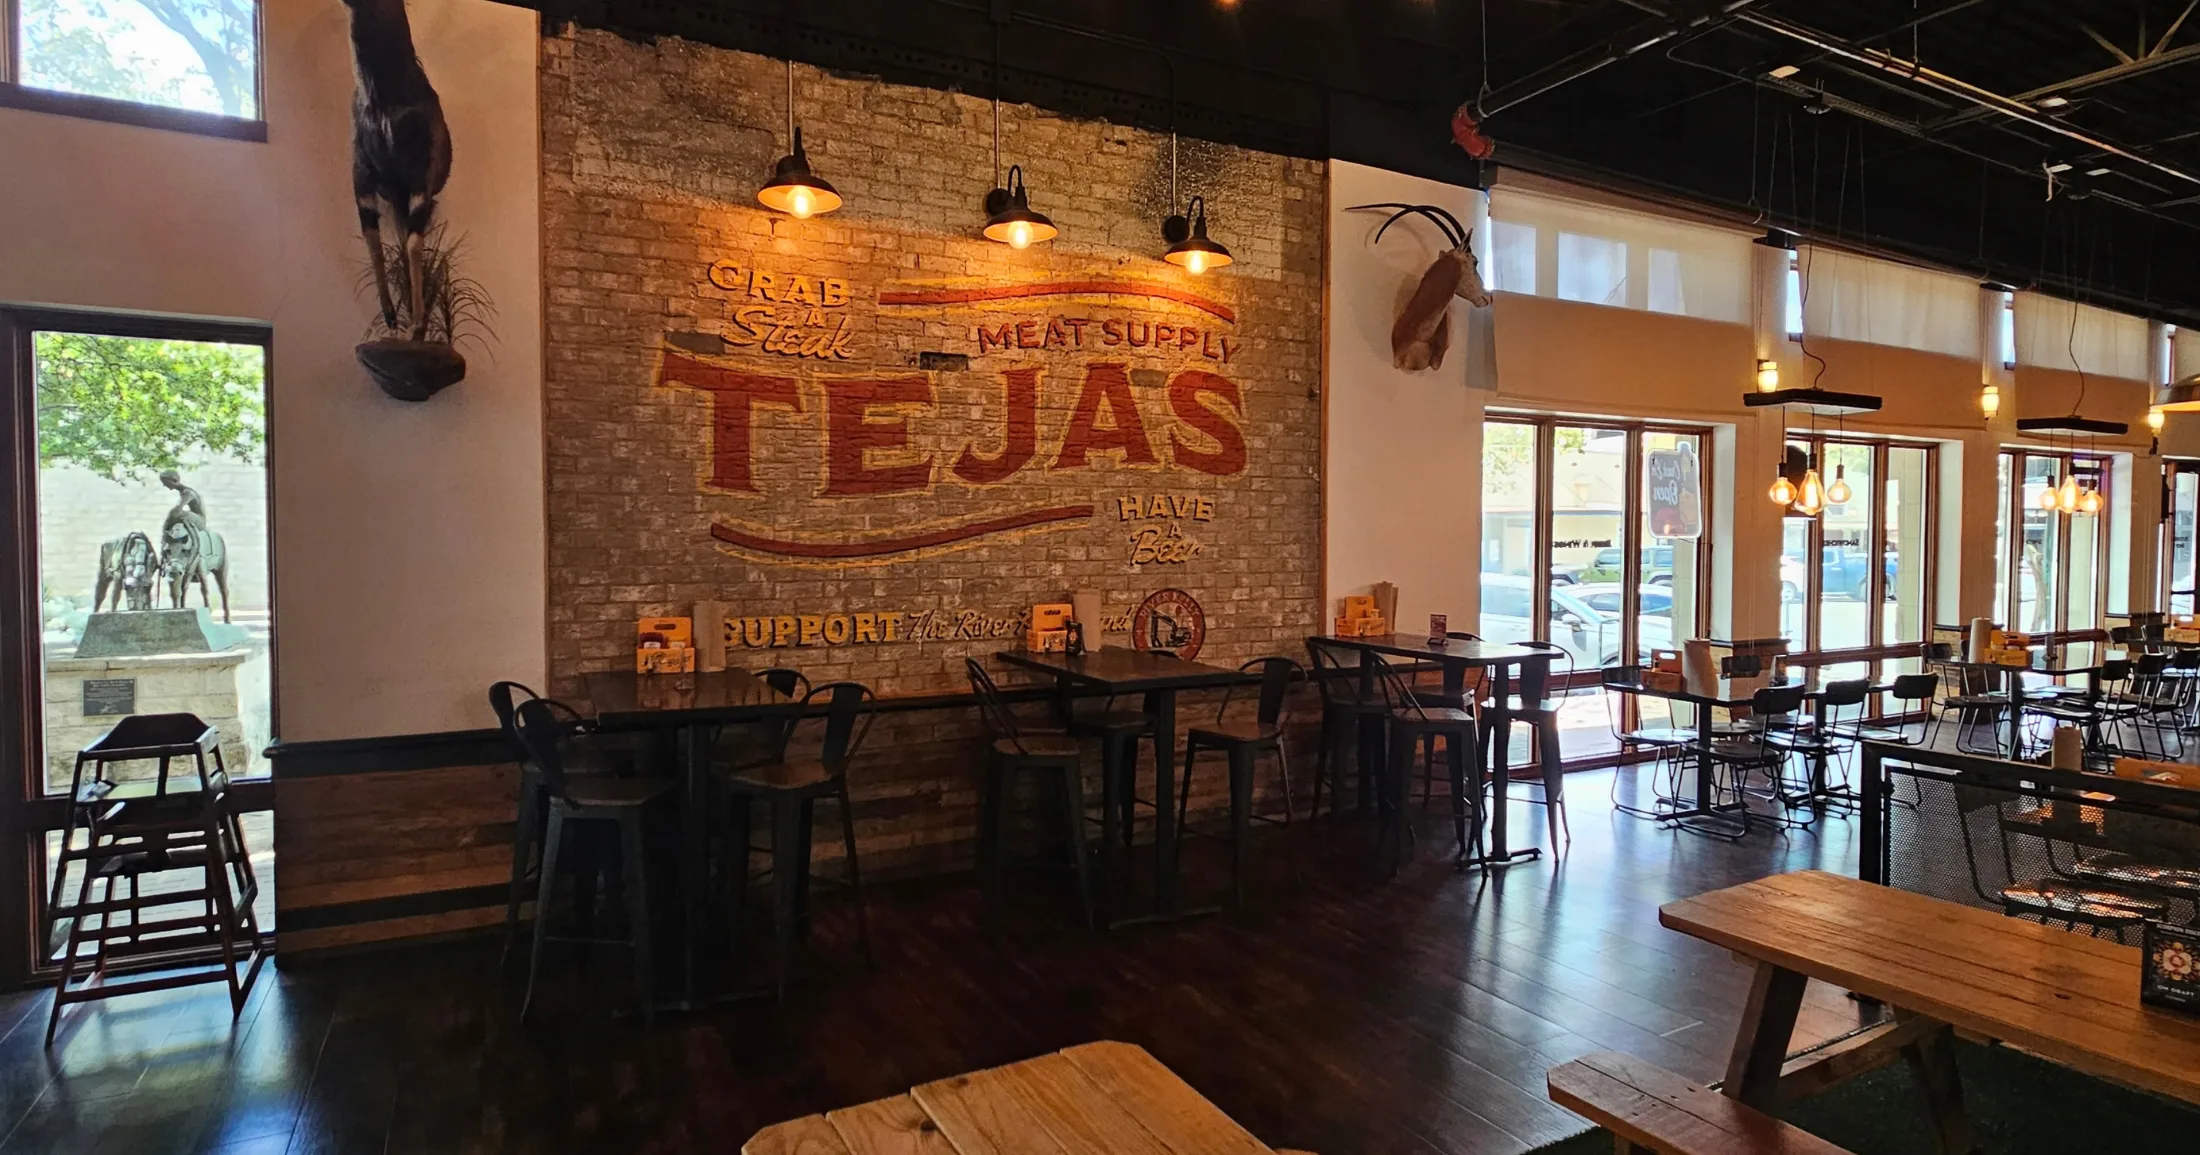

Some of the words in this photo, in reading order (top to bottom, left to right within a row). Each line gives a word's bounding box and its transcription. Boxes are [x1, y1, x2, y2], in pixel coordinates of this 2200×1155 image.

[722, 305, 854, 360] Steak
[978, 318, 1089, 353] MEAT
[1101, 318, 1240, 364] SUPPLY
[655, 348, 1248, 498] TEJAS
[1117, 494, 1214, 522] HAVE
[1129, 524, 1200, 566] Beer
[1167, 521, 1182, 538] A
[907, 609, 949, 640] The
[953, 609, 1012, 639] River
